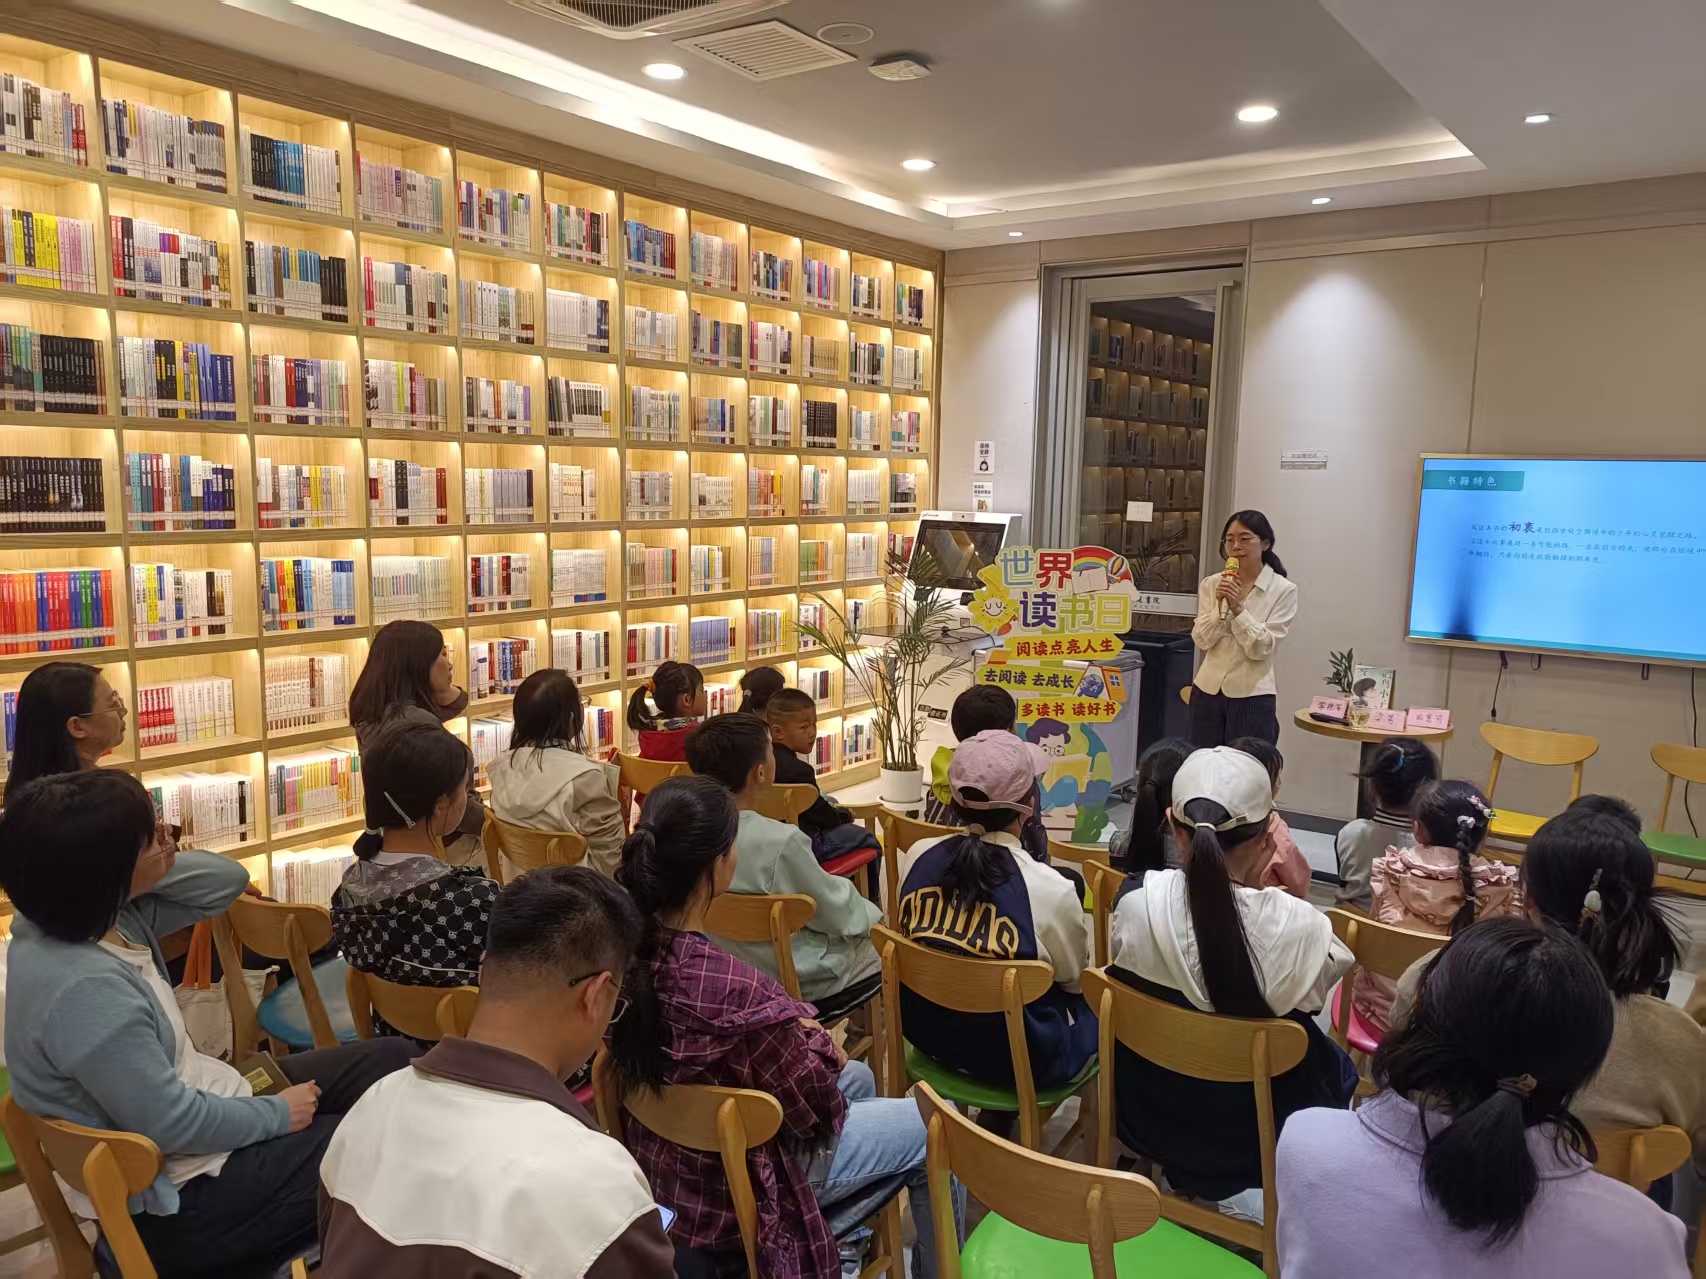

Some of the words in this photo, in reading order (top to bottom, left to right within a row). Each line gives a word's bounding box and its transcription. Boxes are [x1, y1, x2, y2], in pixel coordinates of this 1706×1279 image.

[1448, 476, 1497, 487] 书籍特色
[1000, 550, 1073, 589] 世界
[1019, 591, 1131, 632] 读书日
[1016, 638, 1115, 657] 阅读点亮人生
[984, 668, 1027, 685] 去阅读
[1032, 672, 1075, 689] 去成长
[1021, 703, 1065, 717] 多读书
[1072, 701, 1116, 716] 读好书
